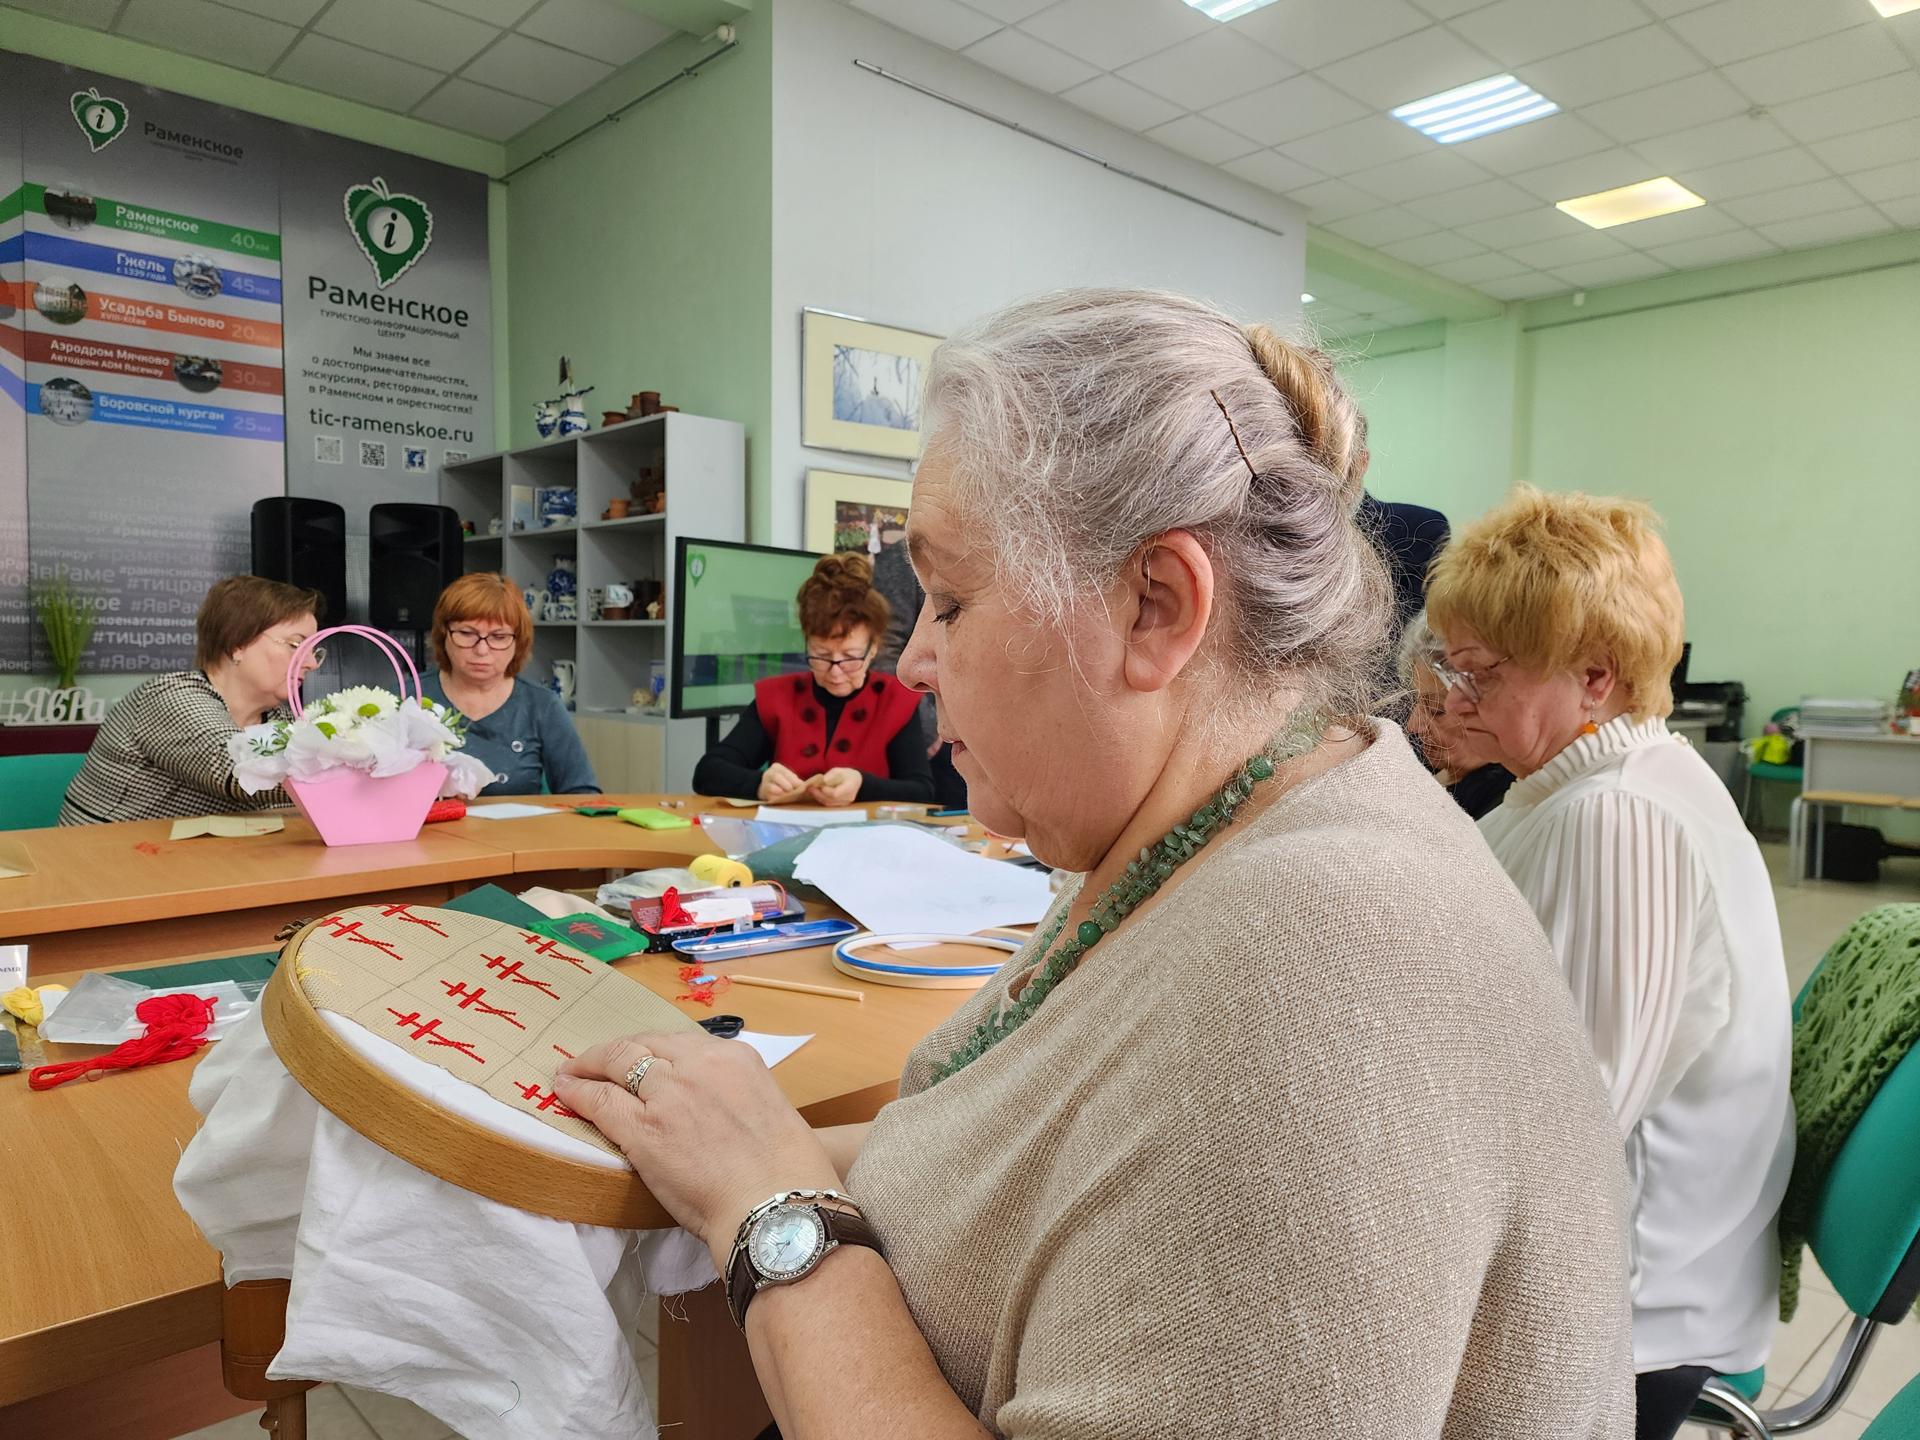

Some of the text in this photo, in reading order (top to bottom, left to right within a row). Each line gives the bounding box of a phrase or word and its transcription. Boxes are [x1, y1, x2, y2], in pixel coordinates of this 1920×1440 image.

[144, 121, 244, 158] Раменское
[115, 204, 200, 233] Раменское
[230, 231, 256, 249] 40
[116, 252, 166, 273] Гжель
[231, 276, 255, 294] 45
[308, 275, 469, 328] Раменское
[98, 297, 225, 330] Усадьба Быково
[231, 323, 255, 341] 20
[377, 329, 406, 340] ЦЕНТР
[50, 340, 170, 367] Аэродром Мячково
[50, 353, 99, 367] Автодром
[353, 346, 430, 367] Мы знаем все
[231, 369, 256, 386] 30
[312, 356, 469, 388] о достопримечательностях,
[302, 369, 478, 401] экскурсиях, ресторанах, отелях
[319, 385, 383, 402] Раменском
[99, 395, 175, 415] Боровской
[178, 406, 225, 422] курган
[232, 415, 257, 432] 25
[309, 408, 474, 443] tic-ramenskoe.ru
[99, 654, 188, 671] #ЯвРаме
